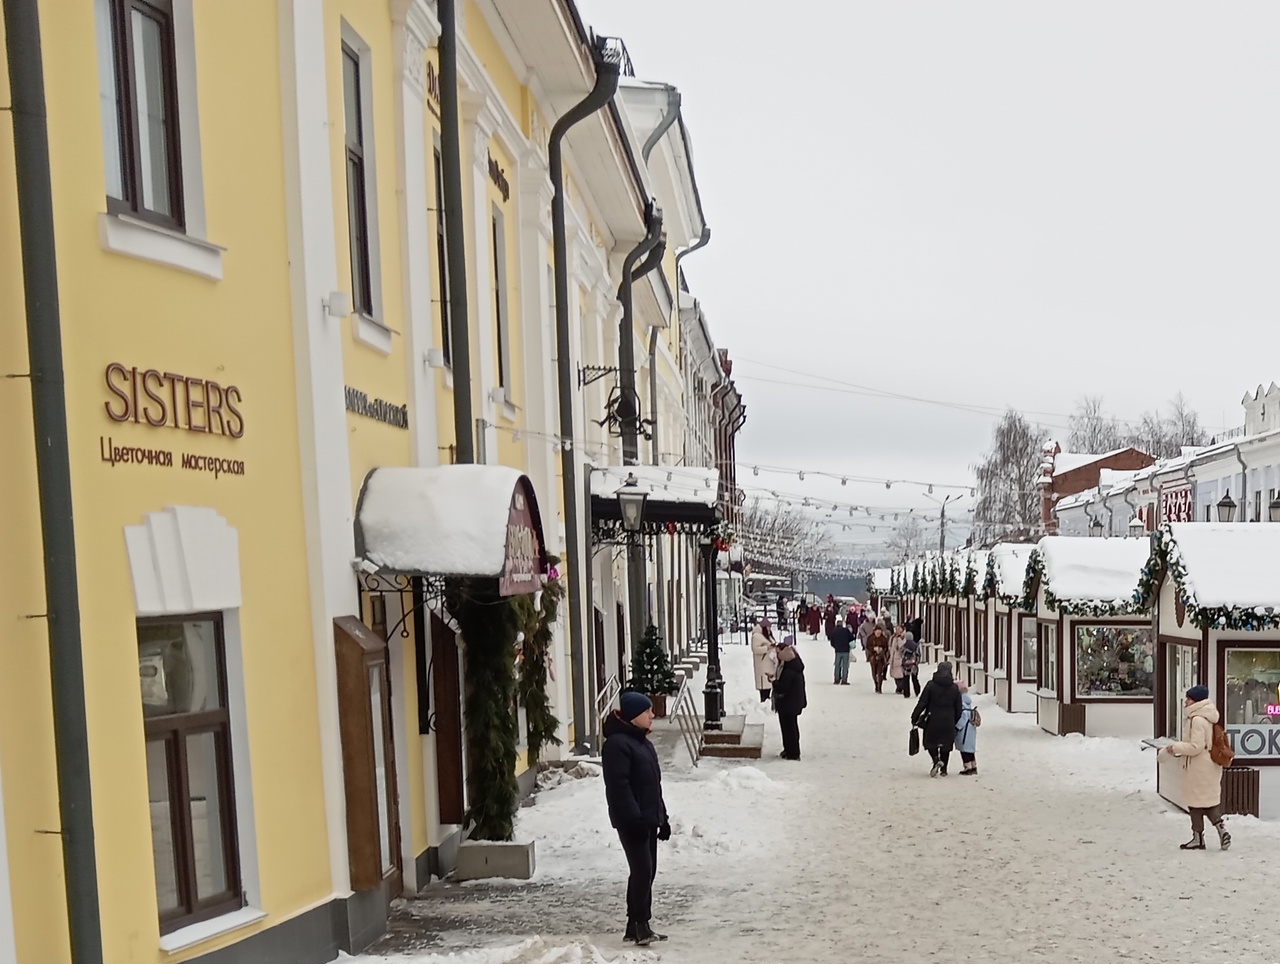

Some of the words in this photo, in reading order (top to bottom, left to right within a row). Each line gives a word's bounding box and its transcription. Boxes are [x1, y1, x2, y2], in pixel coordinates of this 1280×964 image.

[105, 362, 245, 439] SISTERS
[100, 436, 173, 468] Цветочная
[182, 452, 245, 480] мастерская
